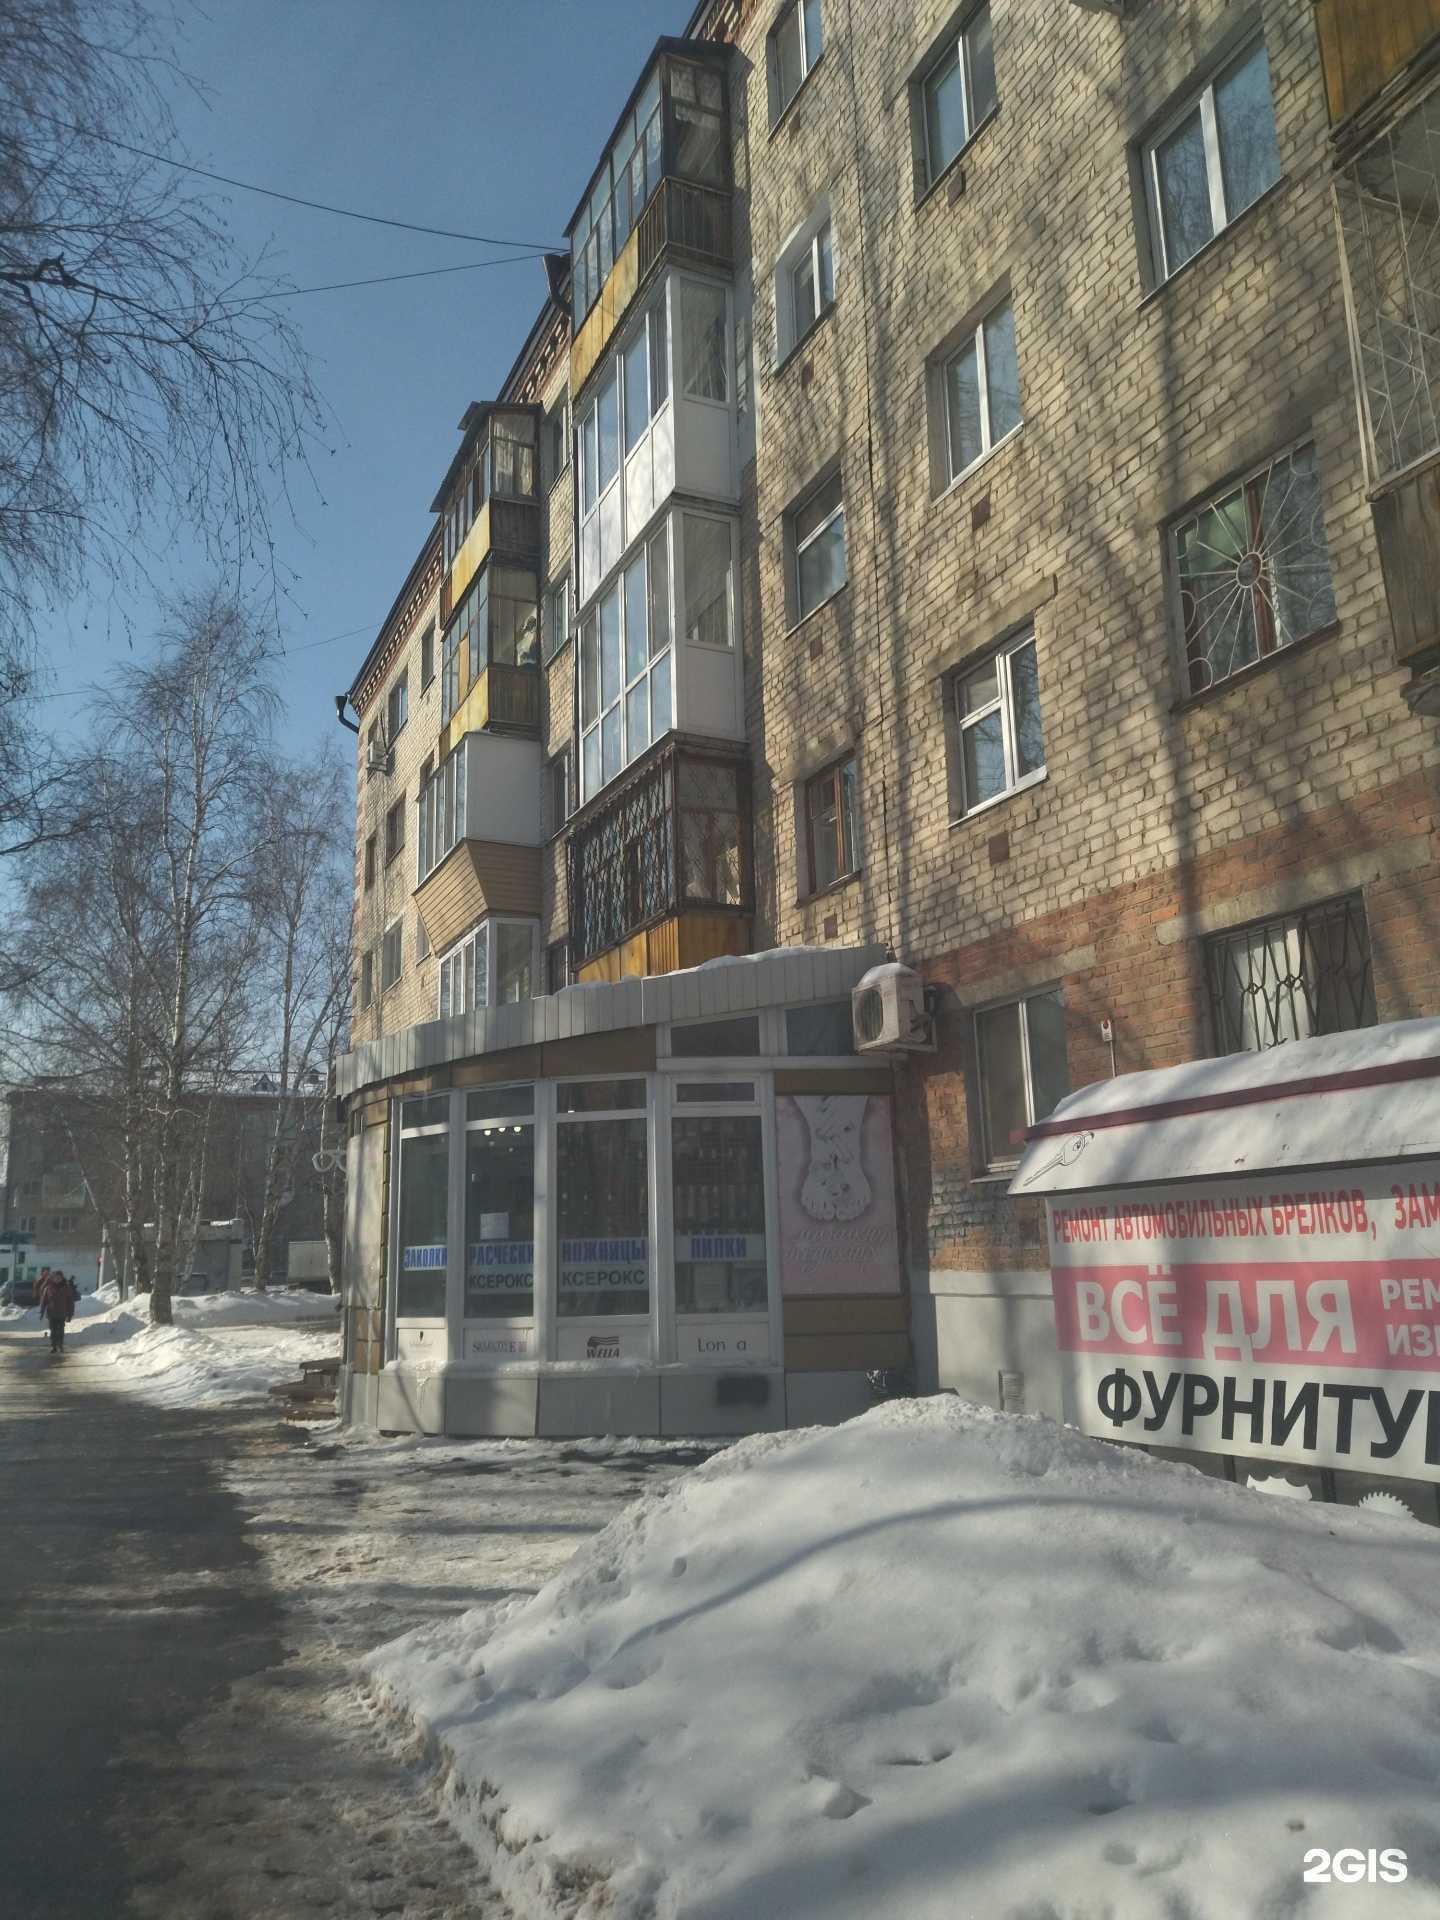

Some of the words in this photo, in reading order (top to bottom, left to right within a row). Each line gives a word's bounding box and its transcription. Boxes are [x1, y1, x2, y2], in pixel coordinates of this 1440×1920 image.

[1053, 1205, 1108, 1243] РЕМОНТ
[1113, 1197, 1267, 1241] АВТОМОБИЛЬНЫХ
[1272, 1188, 1376, 1241] БРЕЛКОВ,
[469, 1272, 534, 1290] КСЕРОКС
[562, 1269, 646, 1287] КСЕРОКС
[1075, 1264, 1183, 1345] ВСЁ
[1202, 1279, 1357, 1362] ДЛЯ
